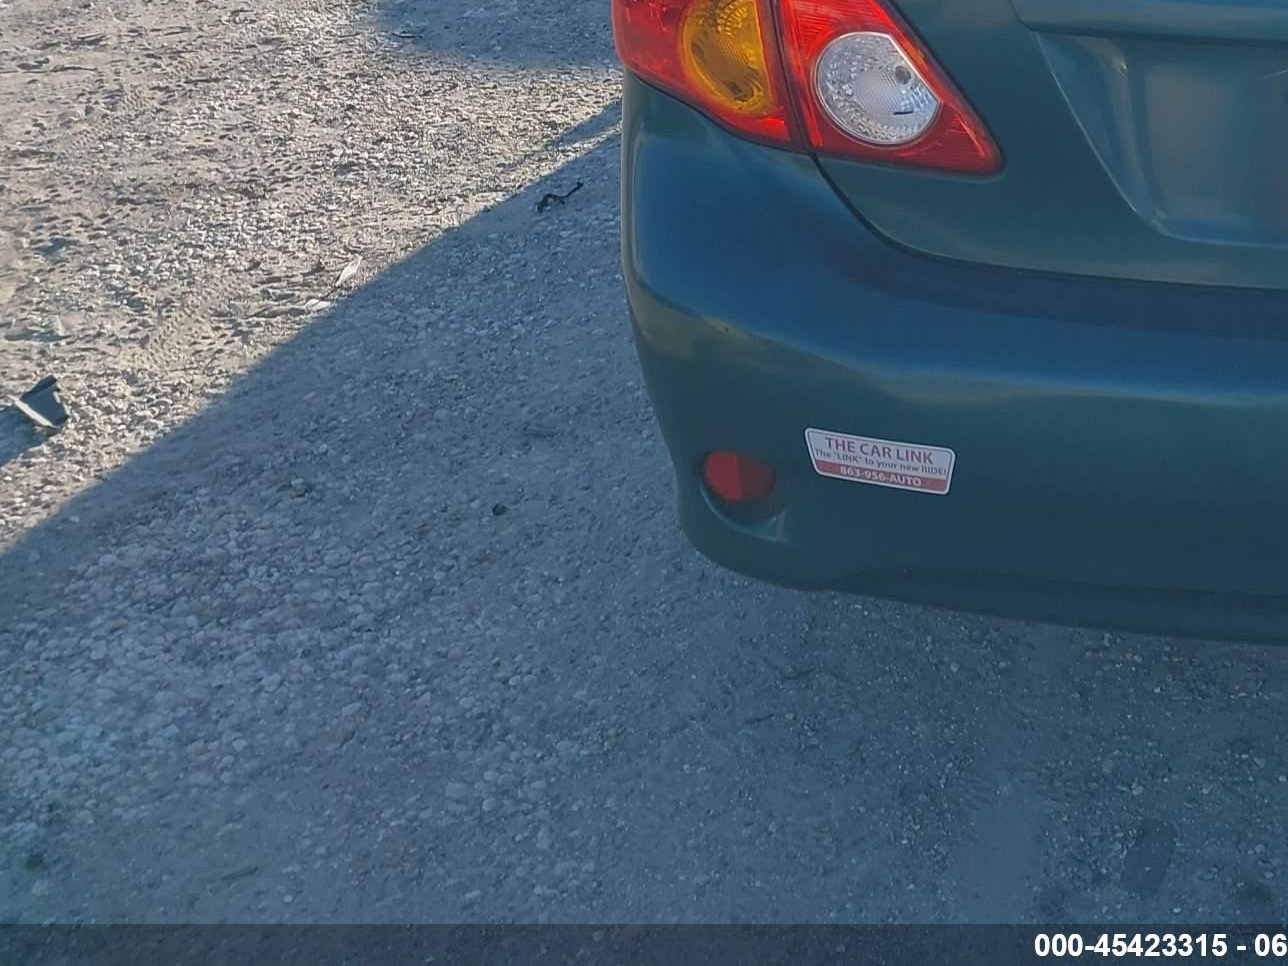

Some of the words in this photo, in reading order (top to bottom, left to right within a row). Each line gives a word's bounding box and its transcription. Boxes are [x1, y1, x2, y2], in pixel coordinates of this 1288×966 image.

[814, 449, 831, 458] The
[865, 457, 875, 466] to
[876, 460, 897, 469] your
[900, 463, 919, 472] new
[825, 437, 856, 454] THE
[860, 443, 892, 459] CAR
[896, 449, 933, 465] LINK
[840, 465, 922, 487] 863-956-AUTO
